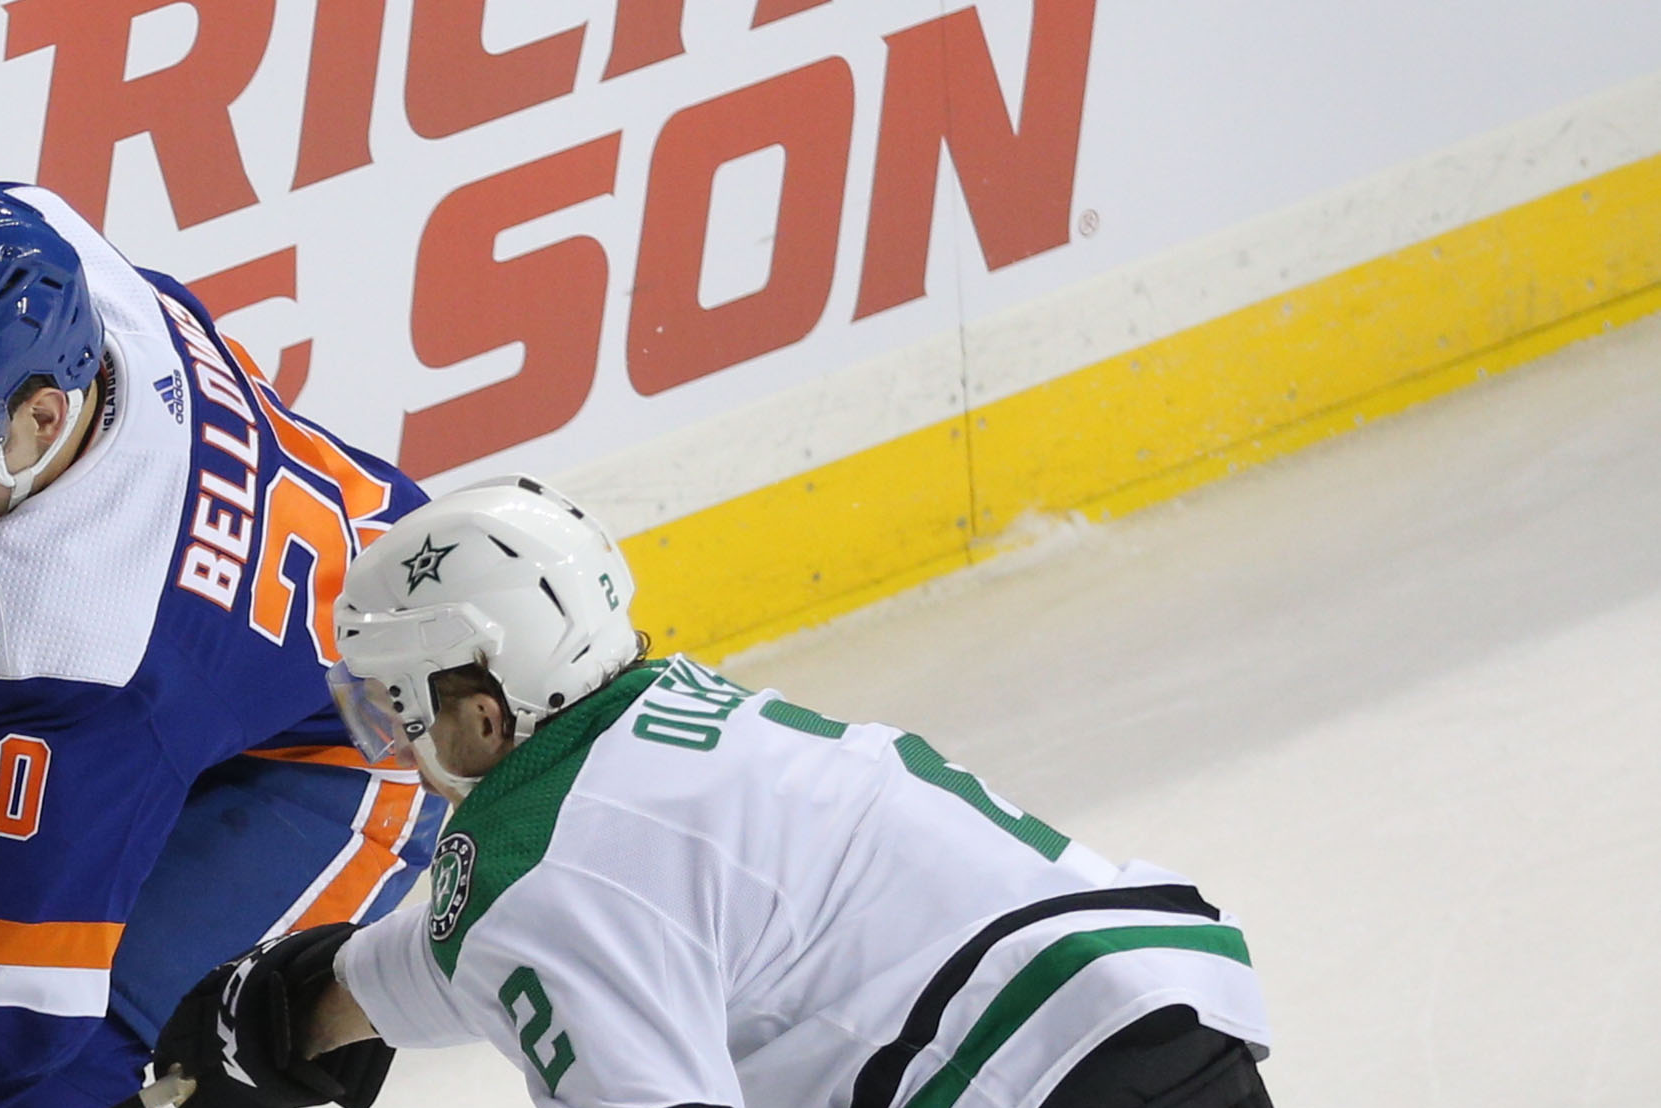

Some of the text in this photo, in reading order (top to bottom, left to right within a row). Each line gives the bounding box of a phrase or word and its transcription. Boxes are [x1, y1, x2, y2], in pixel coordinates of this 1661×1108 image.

[397, 0, 1097, 482] SON
[159, 291, 260, 612] BELLOWS
[172, 368, 185, 425] adidas
[599, 573, 619, 612] 2
[498, 966, 576, 1099] 2
